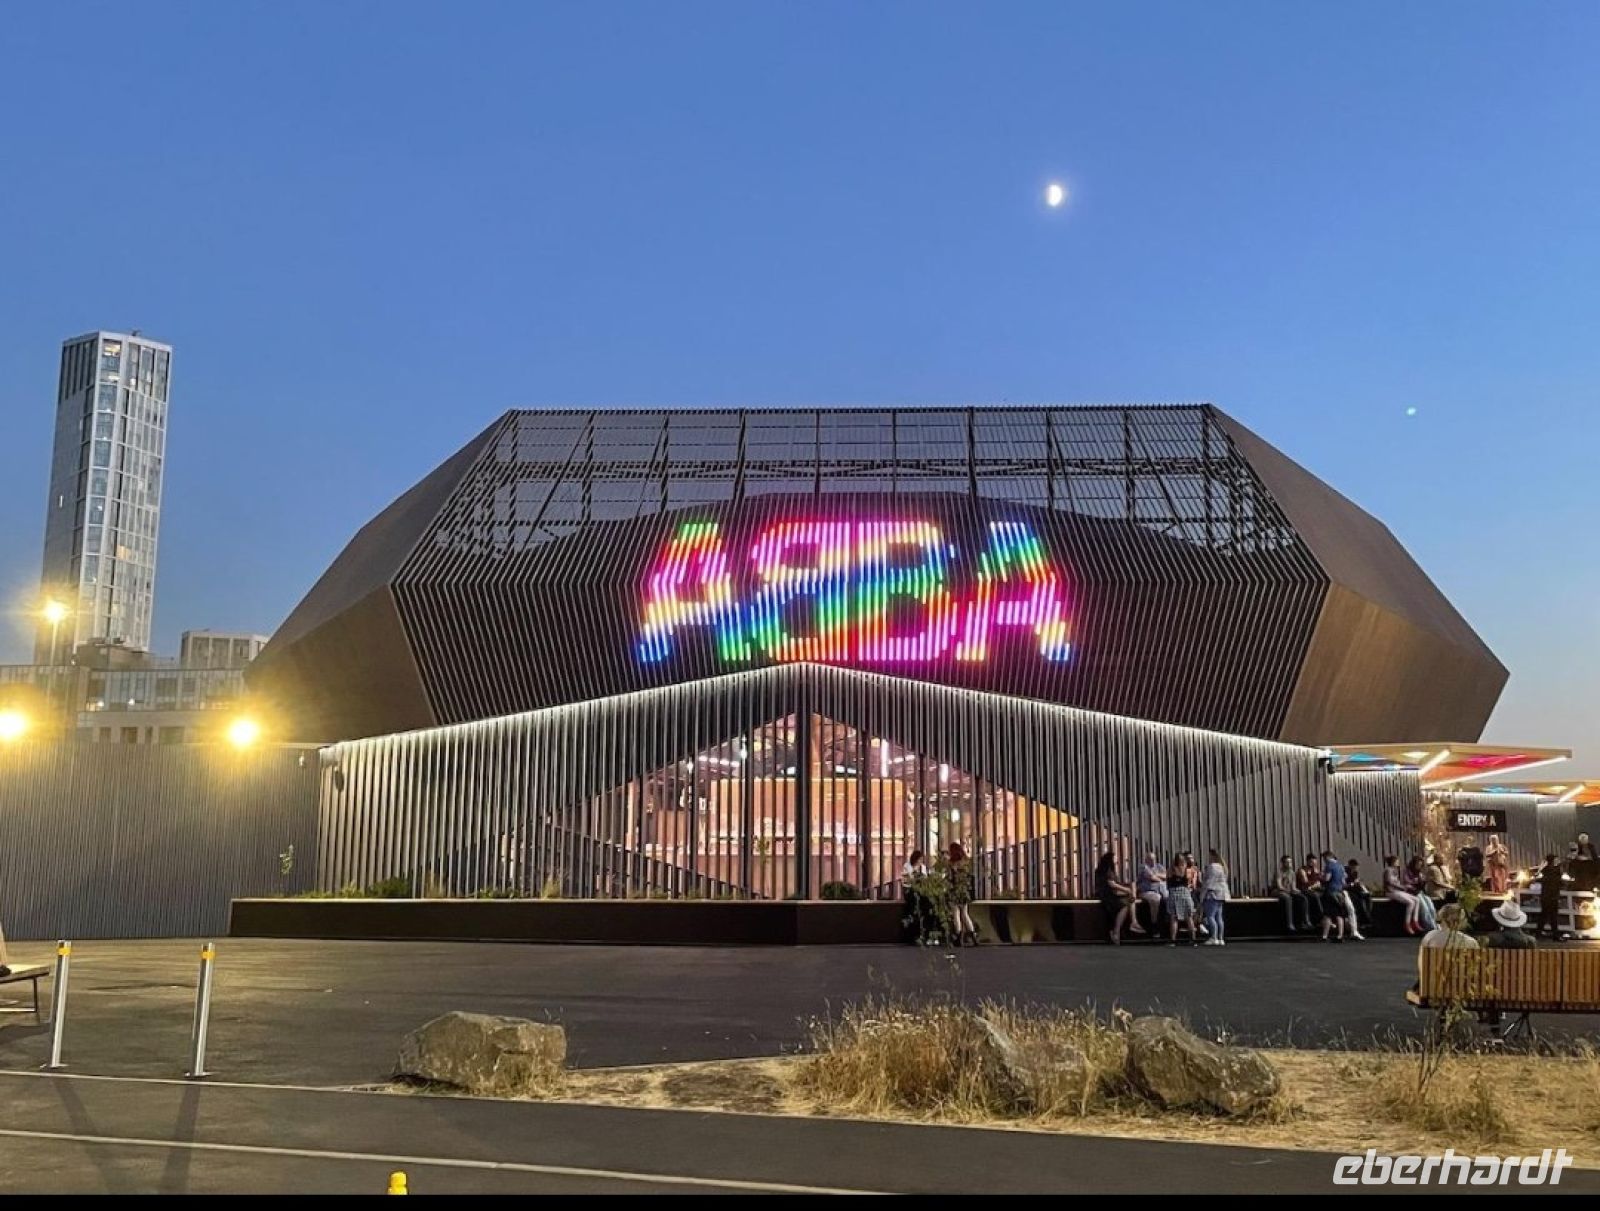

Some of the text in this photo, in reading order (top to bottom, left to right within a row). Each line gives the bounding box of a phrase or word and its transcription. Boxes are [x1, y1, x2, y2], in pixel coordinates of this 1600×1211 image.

[640, 521, 1071, 662] ABBA
[1457, 813, 1497, 827] ENTRY A
